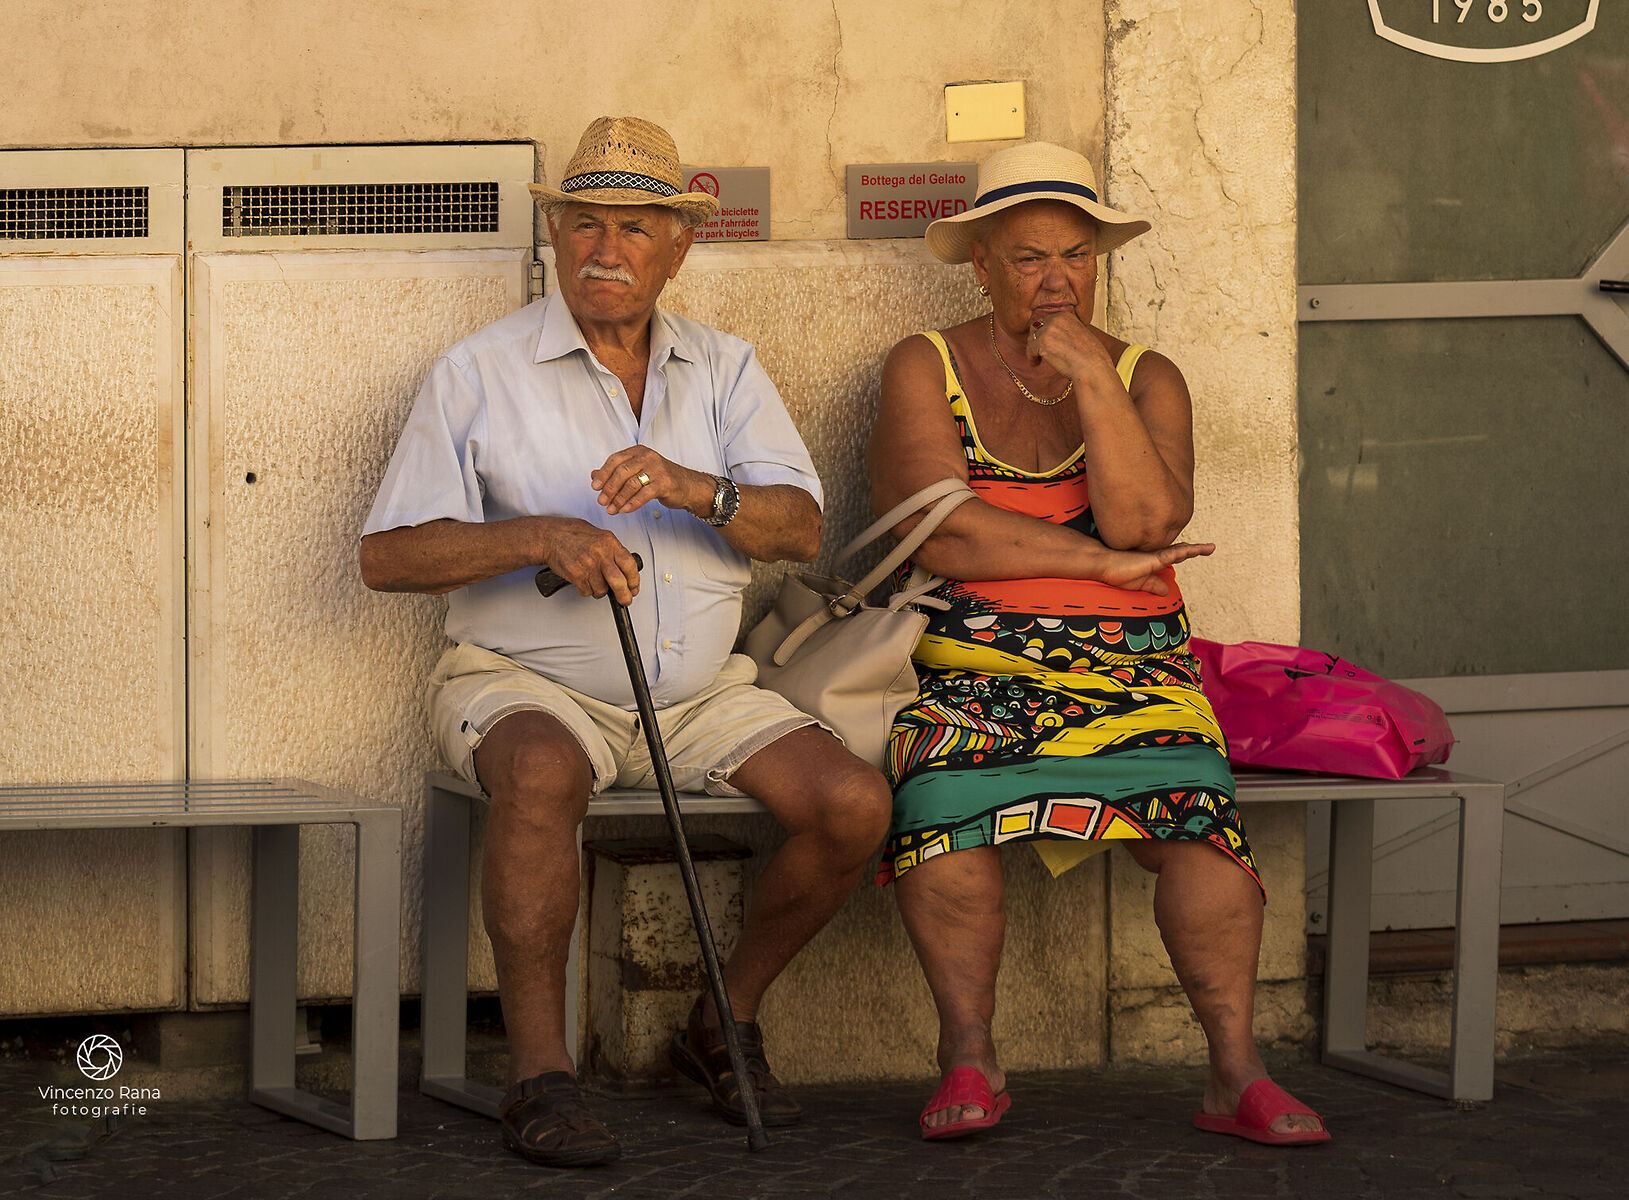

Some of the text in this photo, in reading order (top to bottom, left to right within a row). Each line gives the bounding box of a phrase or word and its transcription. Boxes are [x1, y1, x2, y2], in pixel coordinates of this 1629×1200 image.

[861, 173, 966, 187] Bottega del Gelato
[721, 208, 759, 216] biciclette
[860, 199, 967, 220] RESERVED
[705, 230, 724, 239] park
[726, 229, 759, 239] bicycles
